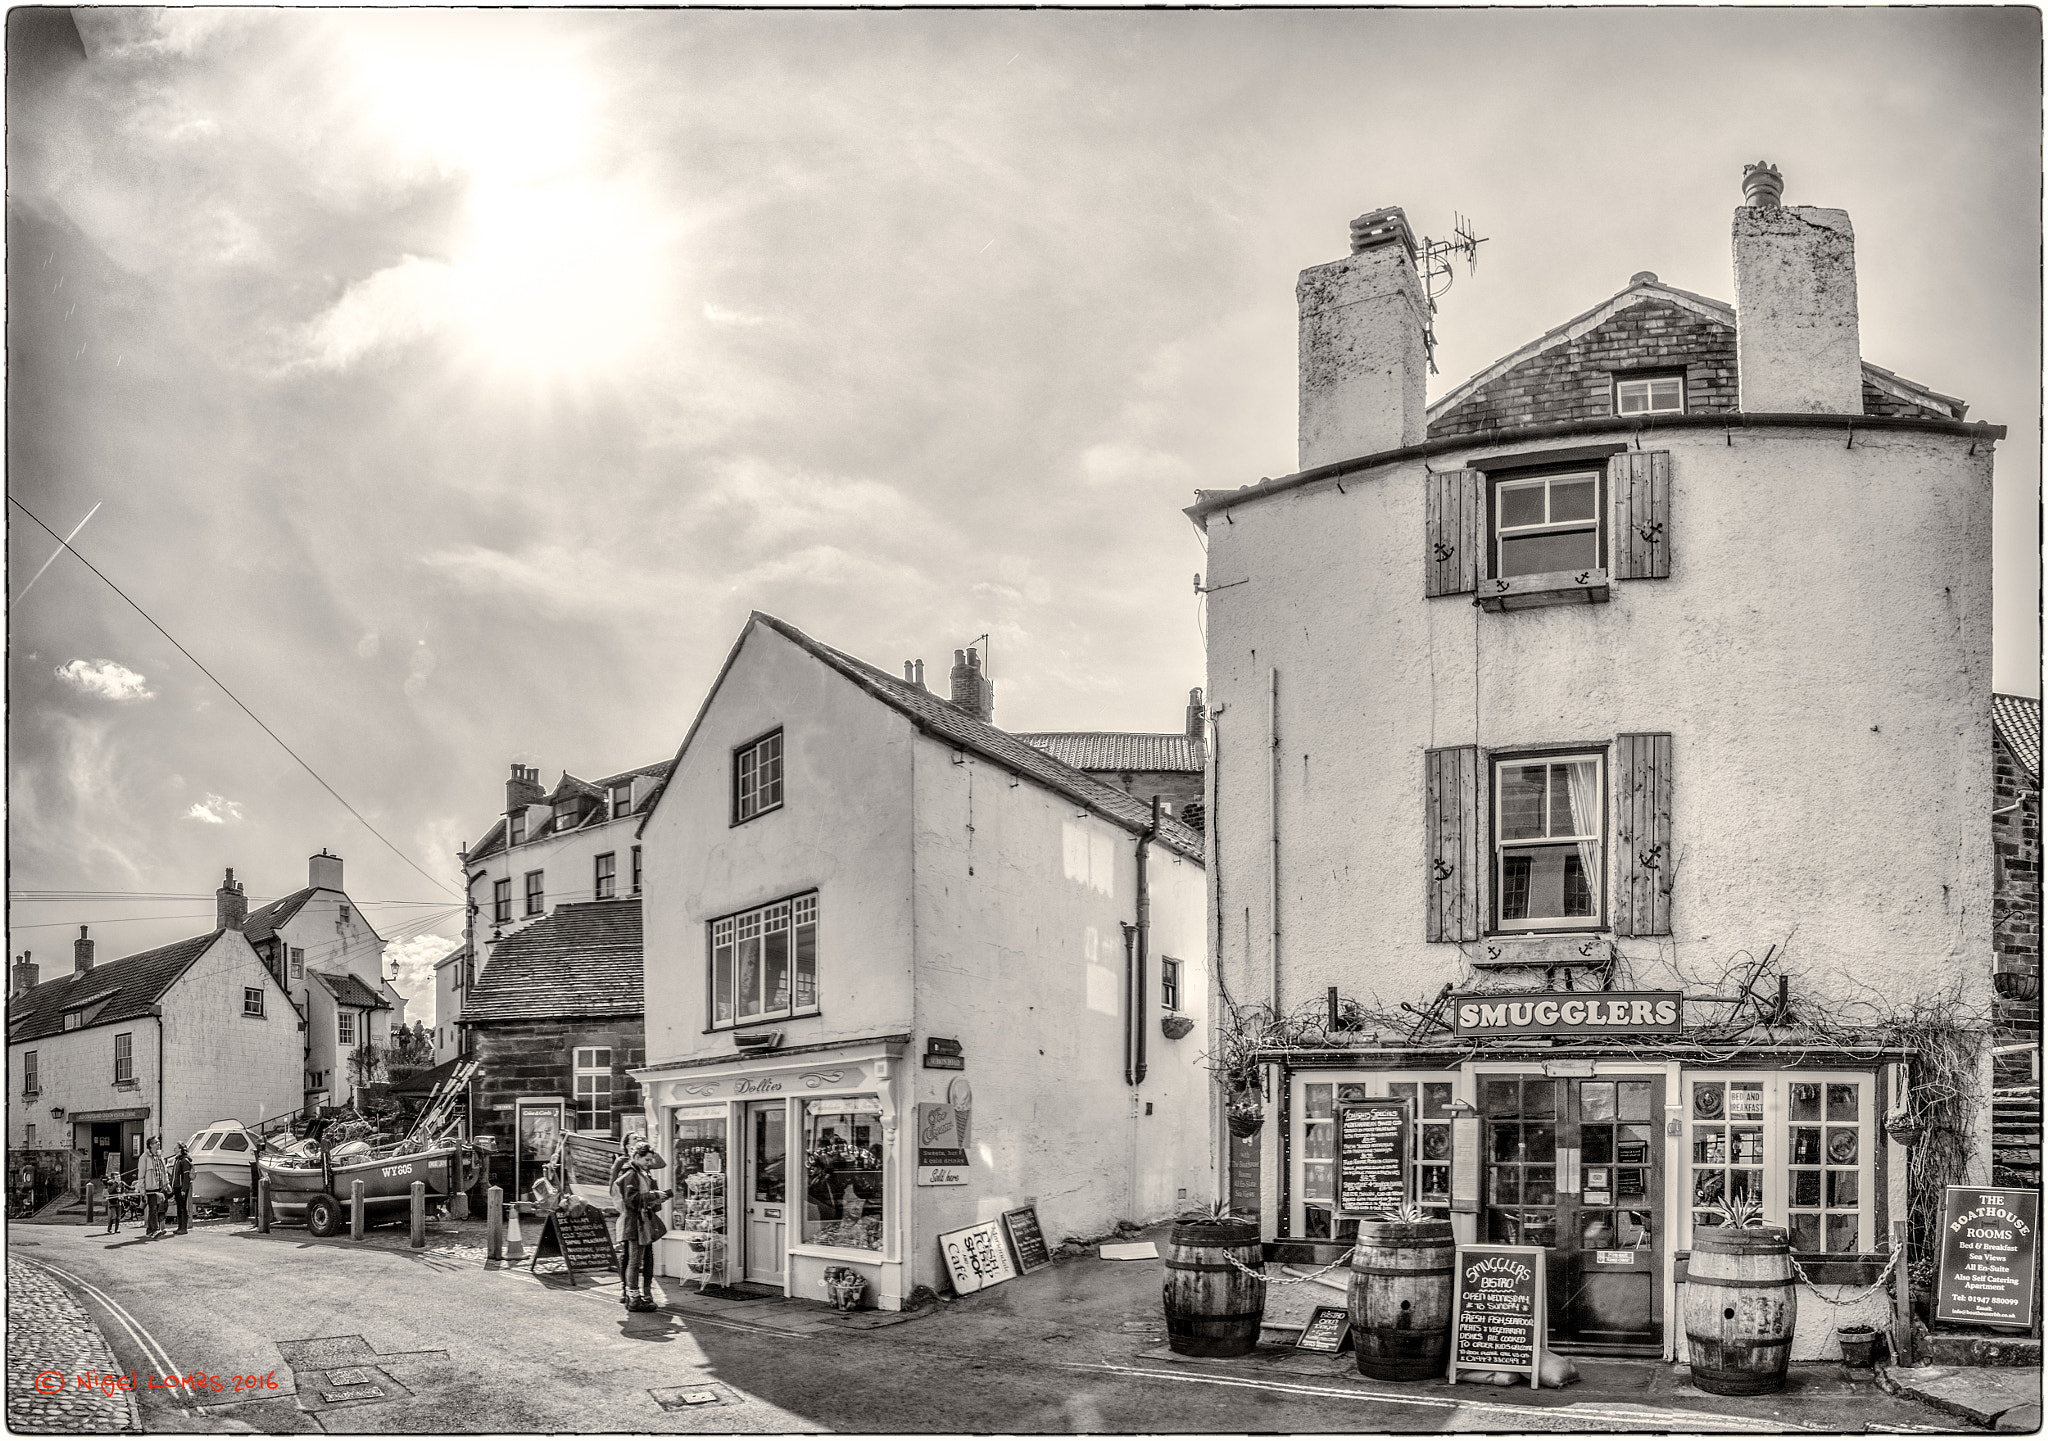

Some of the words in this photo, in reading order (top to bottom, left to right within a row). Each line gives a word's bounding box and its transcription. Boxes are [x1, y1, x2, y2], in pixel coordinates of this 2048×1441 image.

[1459, 1000, 1678, 1029] SMUGGLERS
[734, 1077, 782, 1094] Dollies
[1731, 1092, 1744, 1101] BED
[1747, 1092, 1760, 1101] AND
[927, 1107, 947, 1125] Ice
[922, 1121, 953, 1145] Cream
[930, 1169, 944, 1183] Sold
[945, 1169, 960, 1182] here
[1979, 1195, 2005, 1206] THE
[1950, 1207, 2031, 1237] BOATHOUSE
[1967, 1228, 2013, 1240] ROOMS
[1983, 1243, 2018, 1252] Breakfast
[948, 1243, 968, 1281] Café
[964, 1236, 983, 1278] SHOP
[1984, 1254, 2007, 1262] Views
[1465, 1257, 1532, 1284] SMUGGLERS
[1977, 1264, 2010, 1272] En-Suite
[1480, 1277, 1515, 1288] BISTRO
[1972, 1274, 1986, 1282] Self
[1987, 1276, 2019, 1285] Catering
[1965, 1282, 2005, 1291] Apartment
[1462, 1291, 1486, 1301] OPEN
[1967, 1295, 1989, 1304] 01947
[1991, 1297, 2019, 1305] 880099
[1486, 1302, 1520, 1311] SUNDAY
[1460, 1313, 1486, 1323] FRESH
[1460, 1323, 1482, 1332] MEATS
[1488, 1326, 1526, 1335] VEGETARIAN
[1459, 1332, 1483, 1340] DISHES
[1487, 1334, 1499, 1342] ALL
[1500, 1335, 1526, 1344] COOKED
[1459, 1340, 1471, 1348] TO
